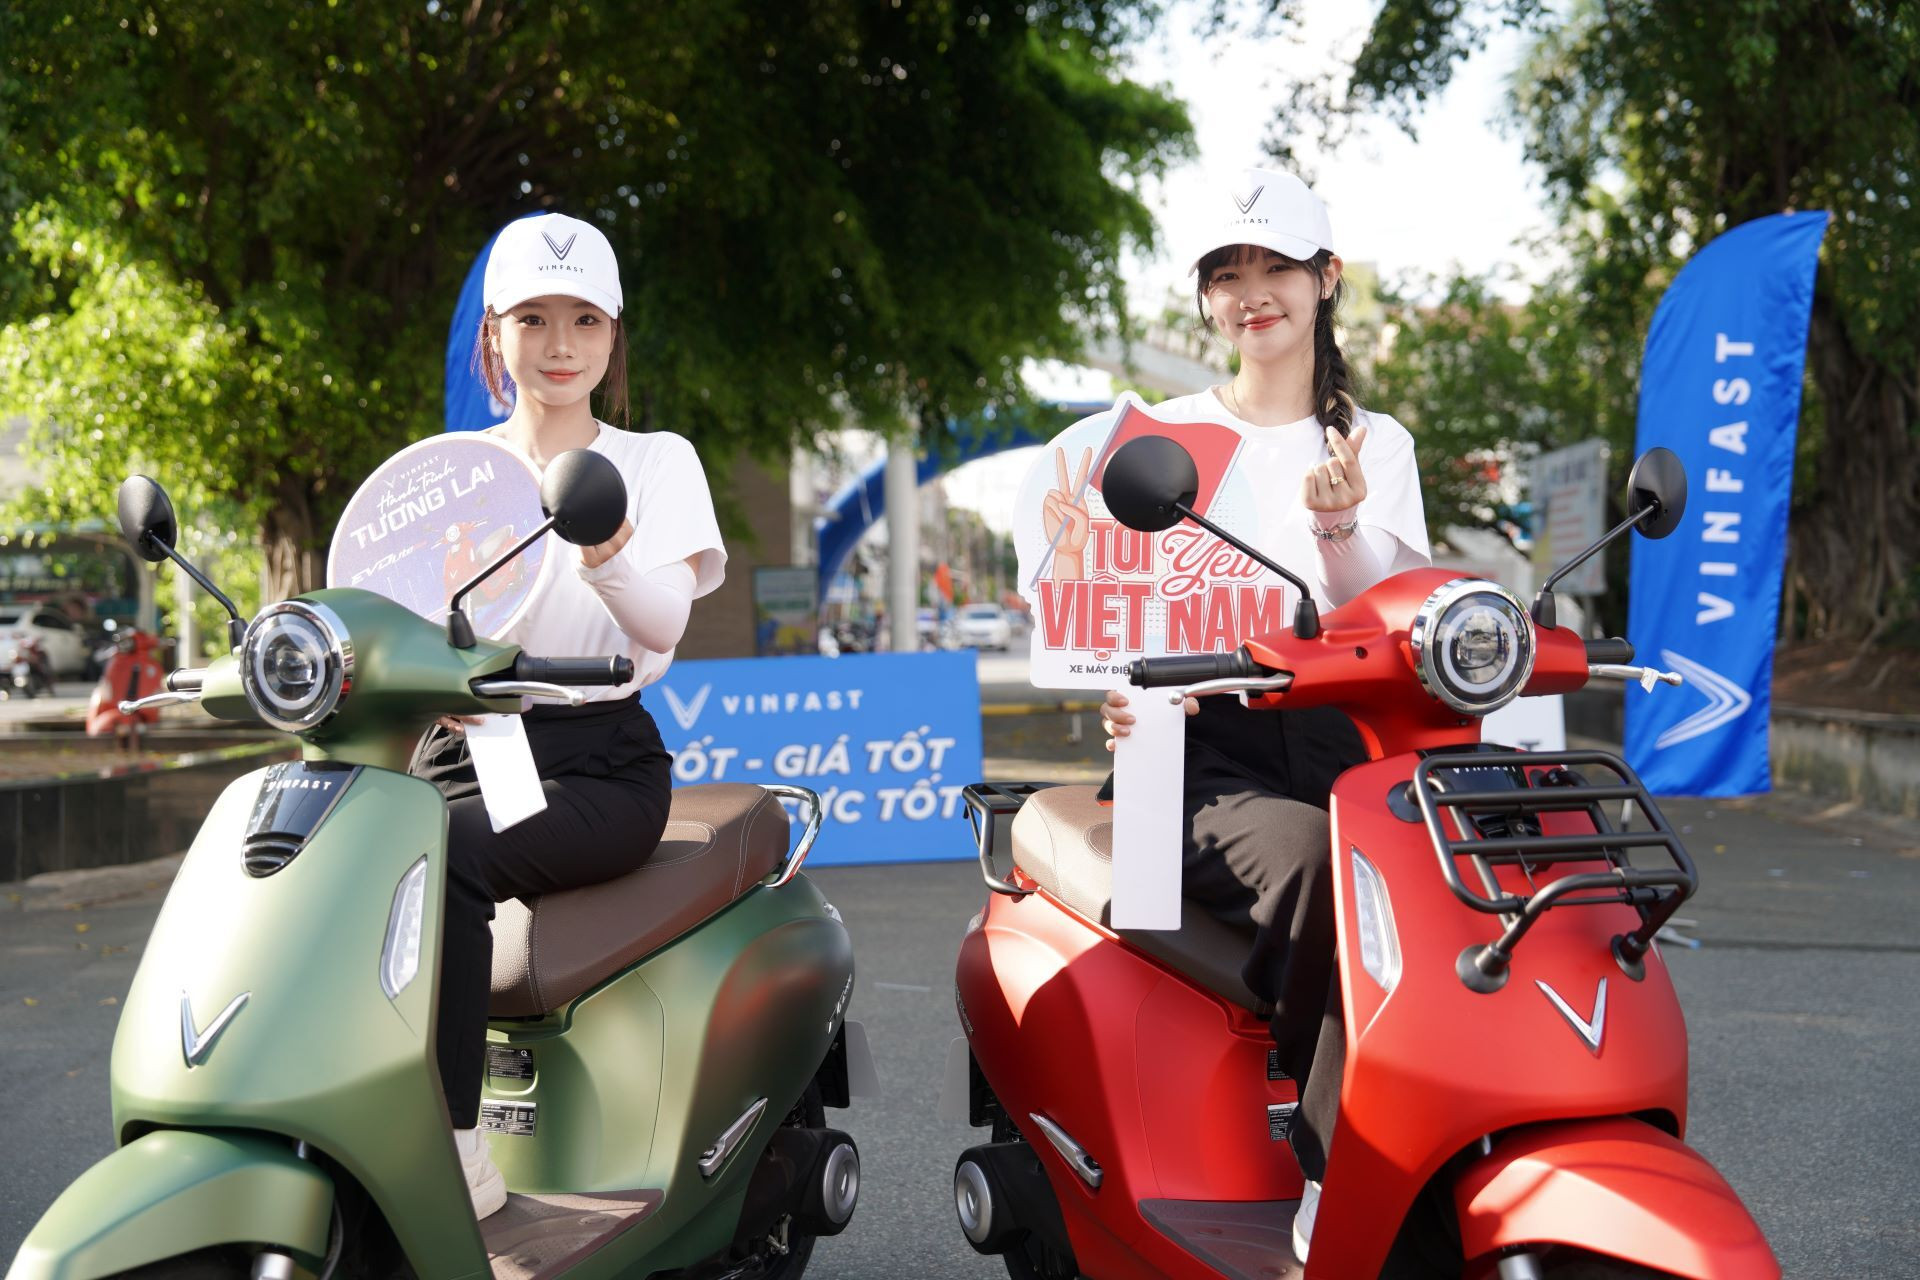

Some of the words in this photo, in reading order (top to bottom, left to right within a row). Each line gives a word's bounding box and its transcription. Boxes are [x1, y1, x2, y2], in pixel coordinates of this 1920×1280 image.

[538, 264, 584, 274] VINFAST
[400, 455, 440, 479] VINFAST
[1695, 333, 1755, 625] VINFAST
[350, 487, 446, 549] TƯƠNG
[451, 460, 495, 498] LAI
[1162, 528, 1264, 596] Yêu
[1037, 572, 1155, 661] VIỆT
[1166, 584, 1285, 654] NAM
[1069, 664, 1083, 674] XE
[1086, 663, 1109, 674] MÁY
[1111, 663, 1129, 677] ĐIỆ
[722, 689, 863, 715] VINFAST
[666, 734, 739, 782] ỐT
[774, 734, 851, 778] GIÁ
[865, 725, 956, 774] TỐT
[266, 779, 332, 792] VINFAST
[876, 772, 965, 822] TỐT
